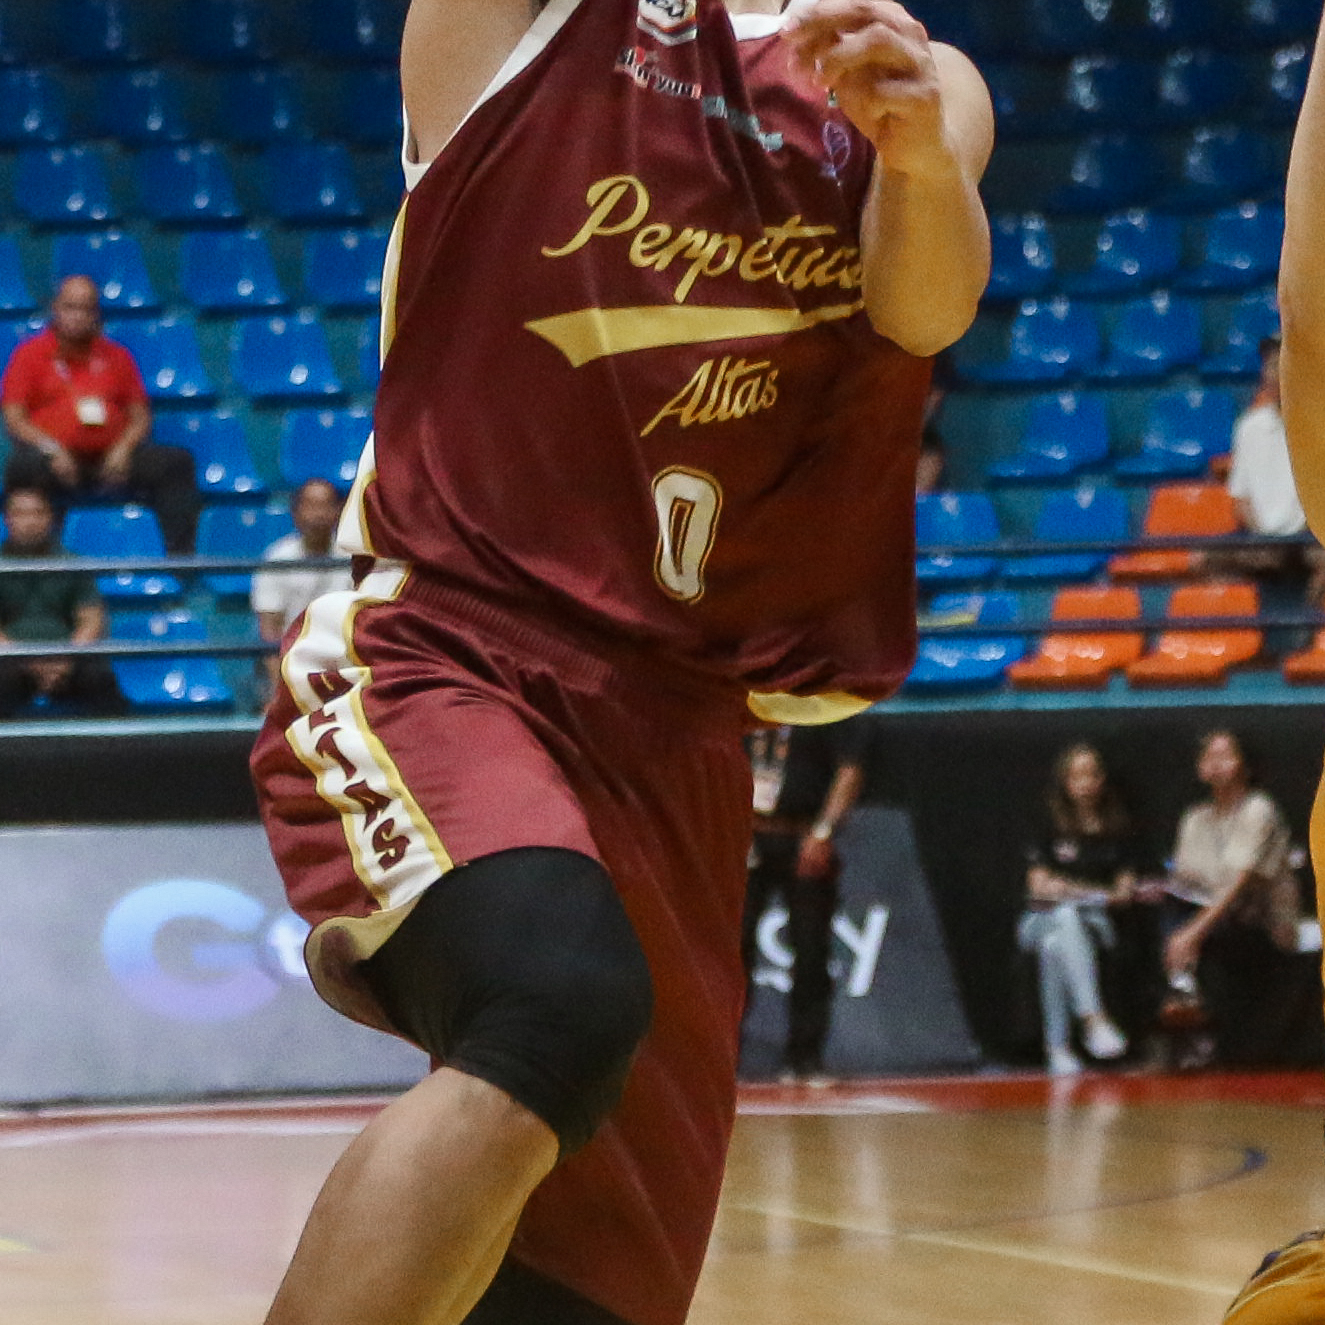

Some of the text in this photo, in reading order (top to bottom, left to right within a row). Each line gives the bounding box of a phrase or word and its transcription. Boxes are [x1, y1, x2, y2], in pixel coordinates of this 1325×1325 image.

[540, 174, 865, 305] Perpetua
[639, 355, 780, 439] Altas
[650, 464, 723, 604] 0
